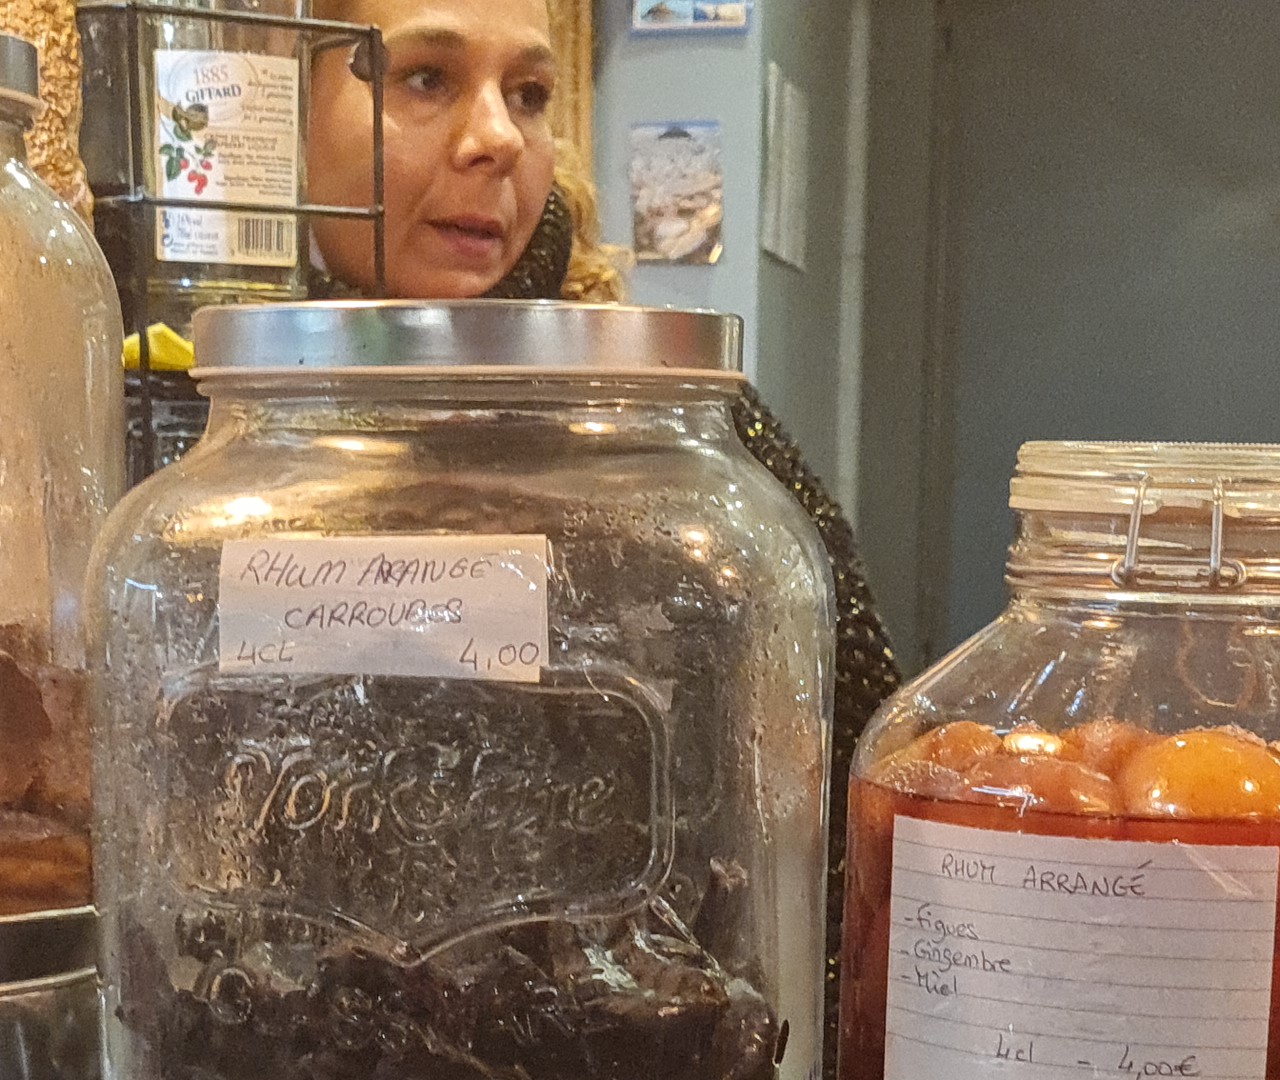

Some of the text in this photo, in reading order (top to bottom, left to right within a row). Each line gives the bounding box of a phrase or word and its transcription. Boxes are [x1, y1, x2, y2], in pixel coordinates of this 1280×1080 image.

[193, 65, 229, 86] 1885
[185, 84, 242, 103] GIFFARD
[460, 638, 539, 671] 4,00
[941, 853, 1153, 898] RHUM ARRANGÉ
[996, 1032, 1035, 1064] 4cl
